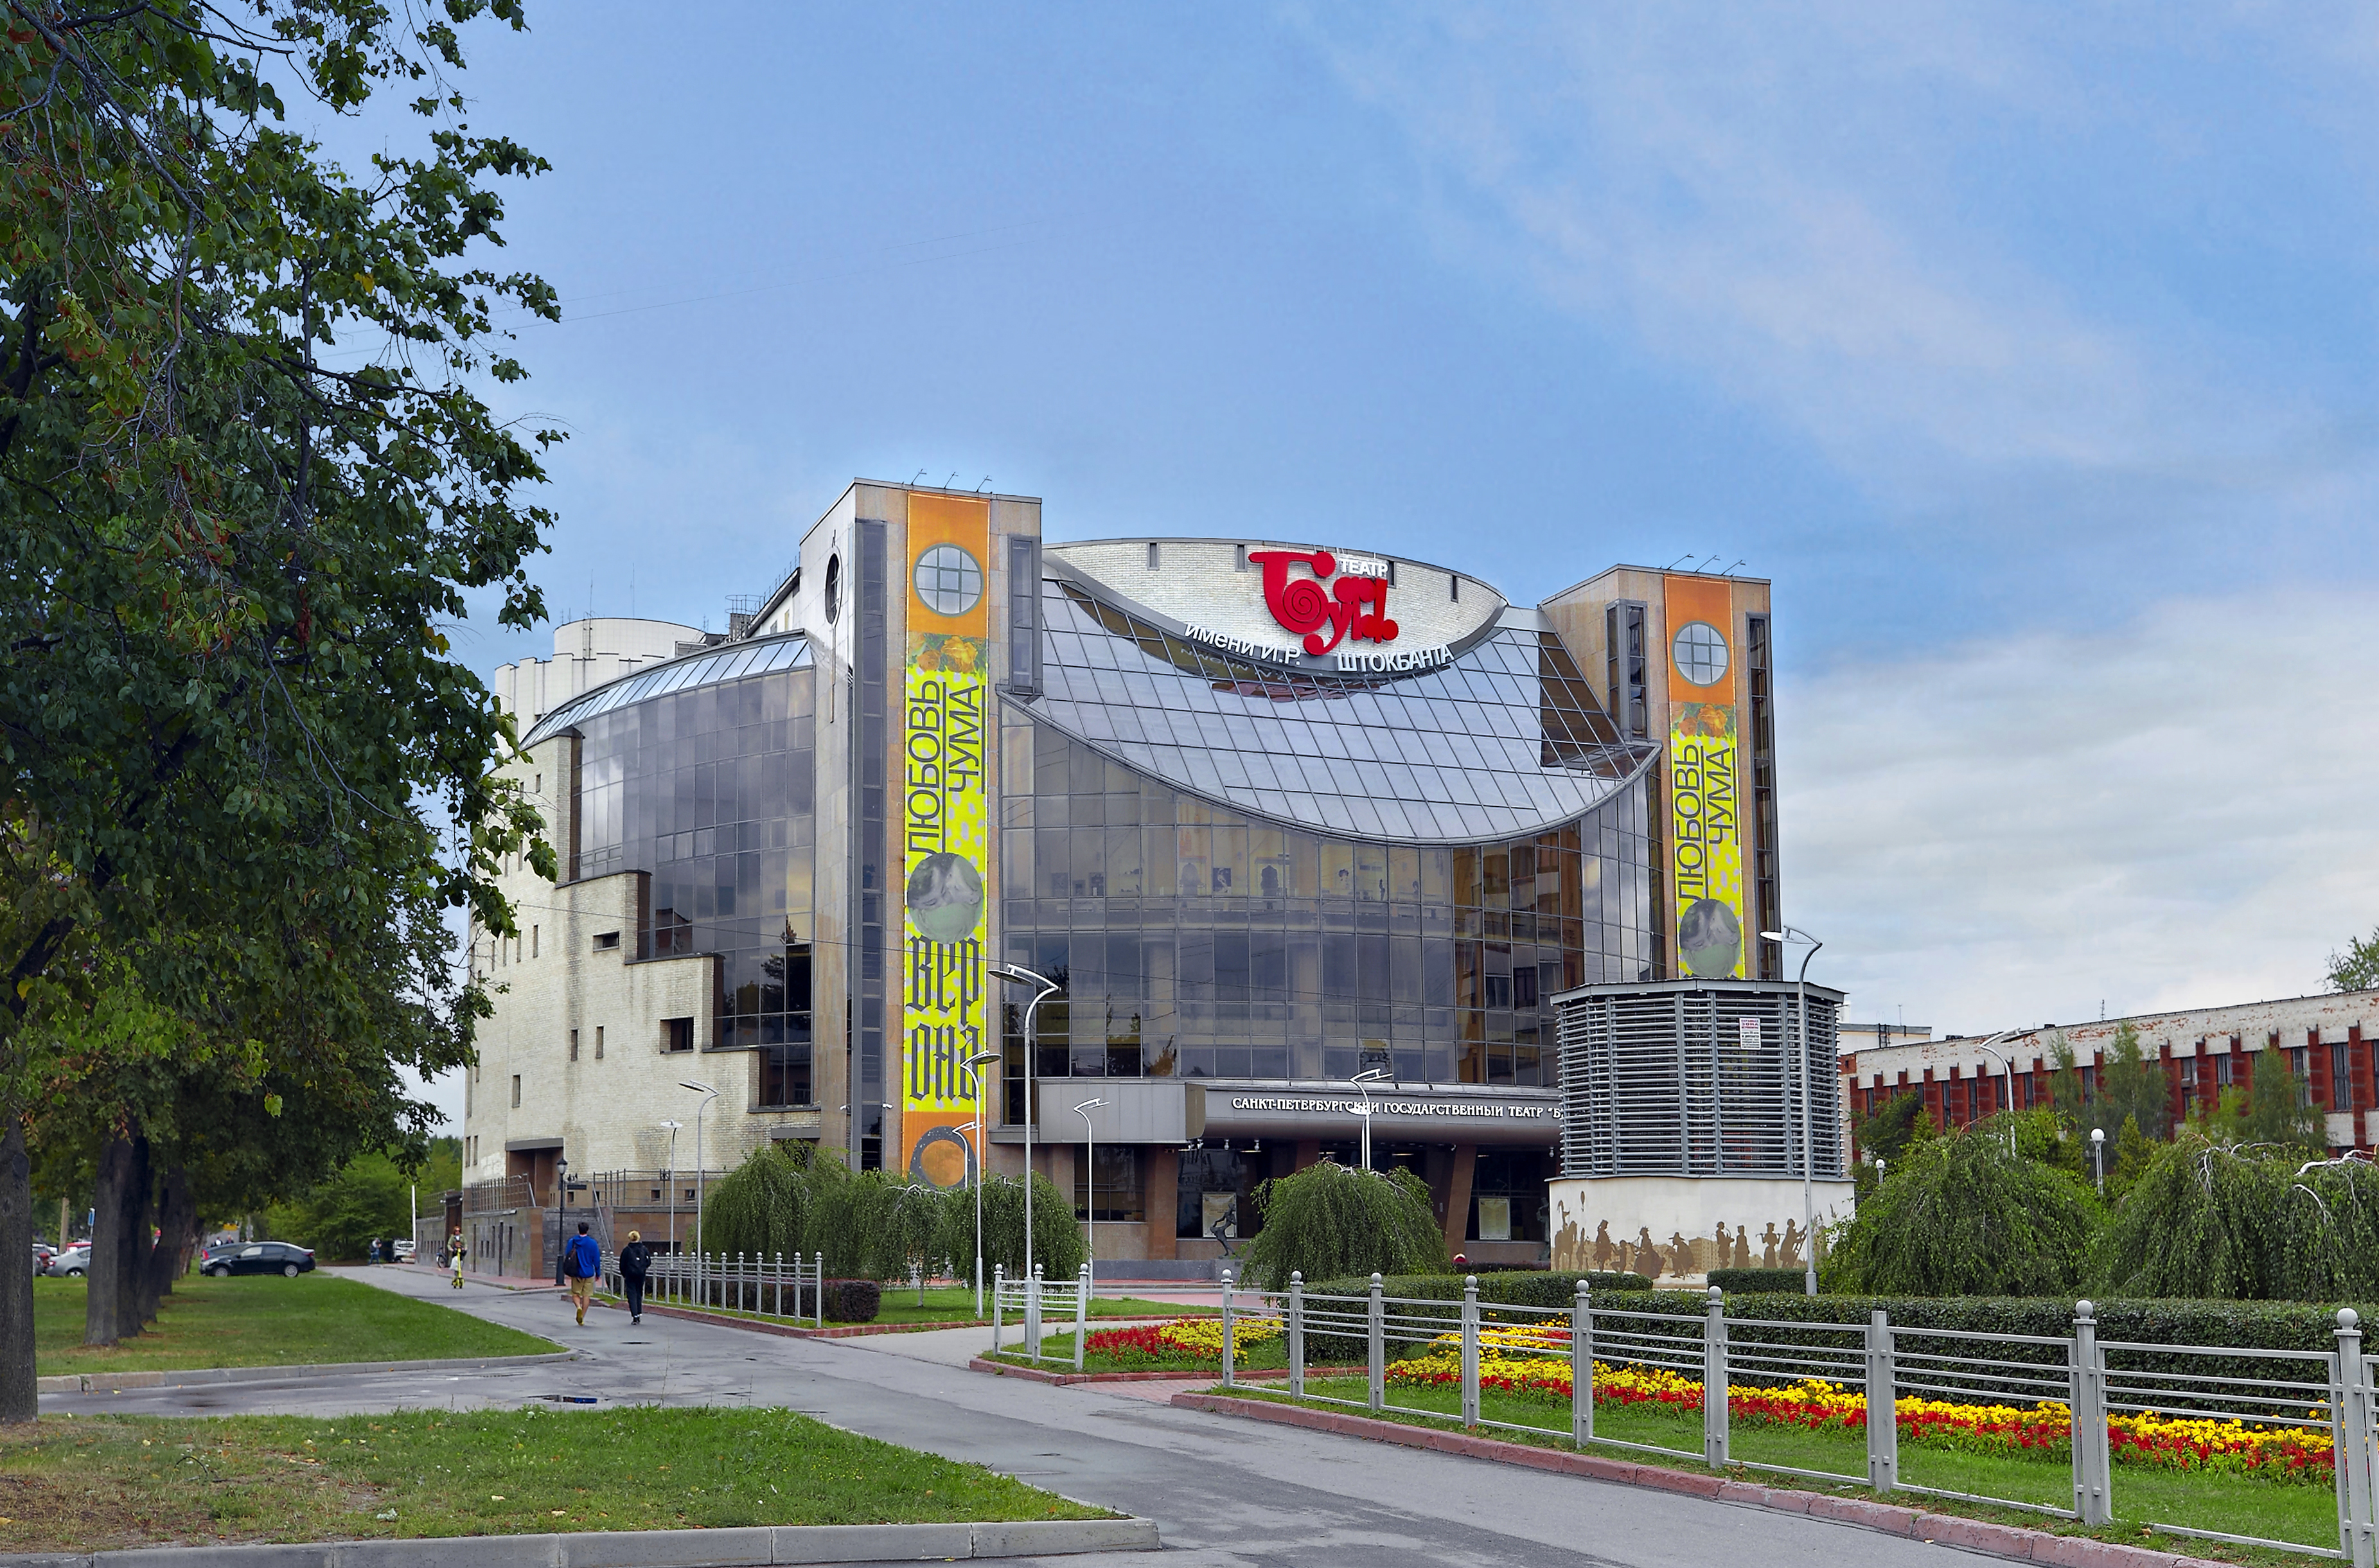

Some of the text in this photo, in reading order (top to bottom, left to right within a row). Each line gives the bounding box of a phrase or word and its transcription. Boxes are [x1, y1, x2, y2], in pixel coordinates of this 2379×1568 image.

[1340, 558, 1388, 577] ТЕАТР
[1185, 622, 1255, 656] имени
[1260, 642, 1301, 665] И.Р.
[1338, 643, 1455, 673] ШТОКБАНТА
[908, 680, 941, 856] ЛЮБОВЬ
[948, 685, 979, 793] ЧУМА
[1674, 744, 1704, 901] ЛЮБОВЬ
[1706, 748, 1733, 845] ЧУМА
[1508, 1106, 1544, 1118] ТЕАТР
